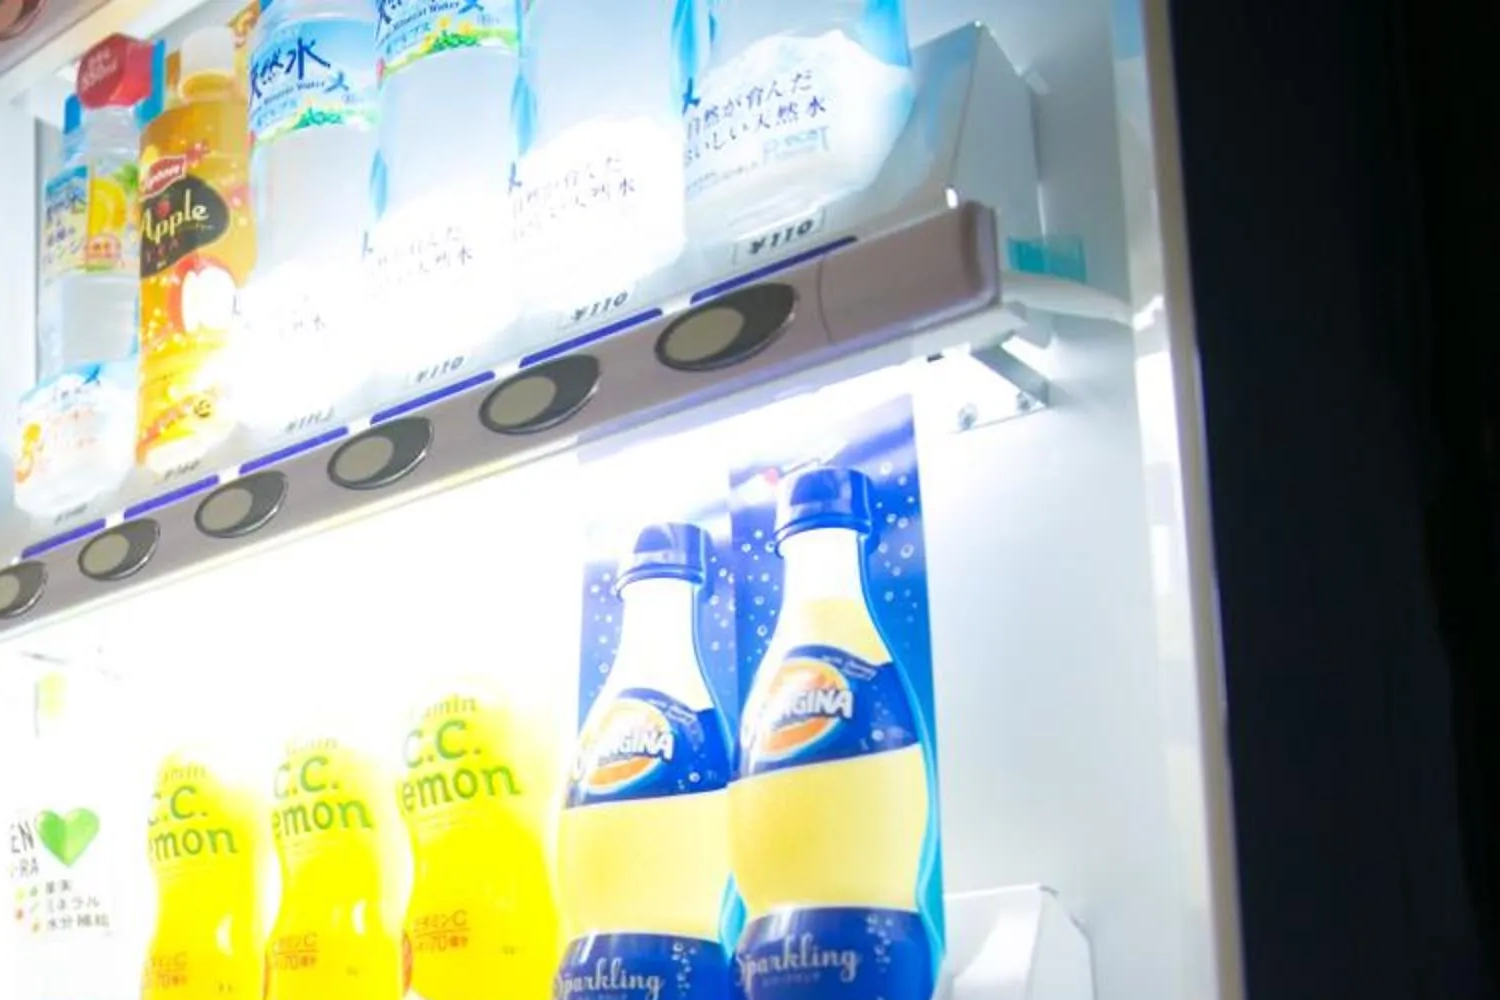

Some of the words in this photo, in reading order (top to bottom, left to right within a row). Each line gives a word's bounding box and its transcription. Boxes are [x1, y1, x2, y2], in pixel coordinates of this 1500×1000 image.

[142, 188, 210, 245] Apple
[747, 217, 815, 256] ¥110
[570, 291, 629, 322] ¥110
[402, 719, 482, 769] C.C.
